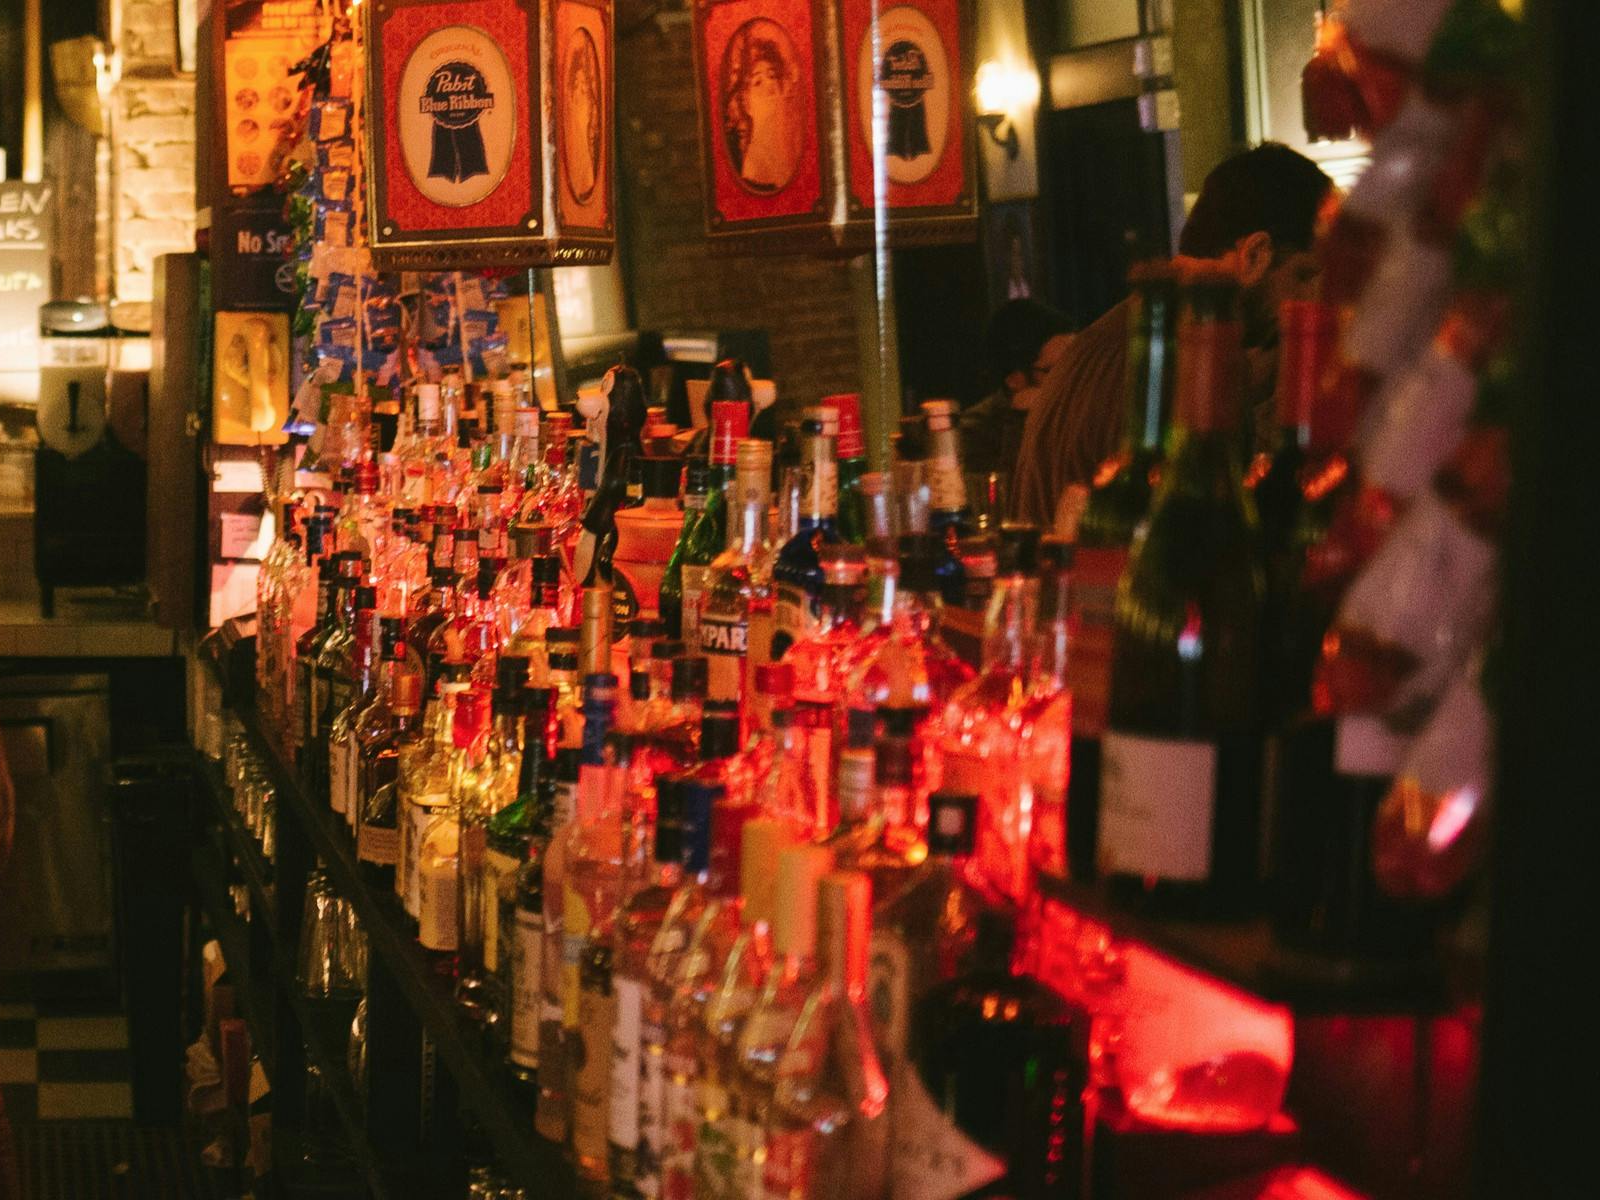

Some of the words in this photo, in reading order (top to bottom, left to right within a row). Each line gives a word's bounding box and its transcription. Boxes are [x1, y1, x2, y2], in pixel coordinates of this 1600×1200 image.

[434, 70, 477, 93] Pabst
[420, 96, 450, 113] Blue
[449, 93, 493, 111] Ribbon
[236, 229, 263, 254] No
